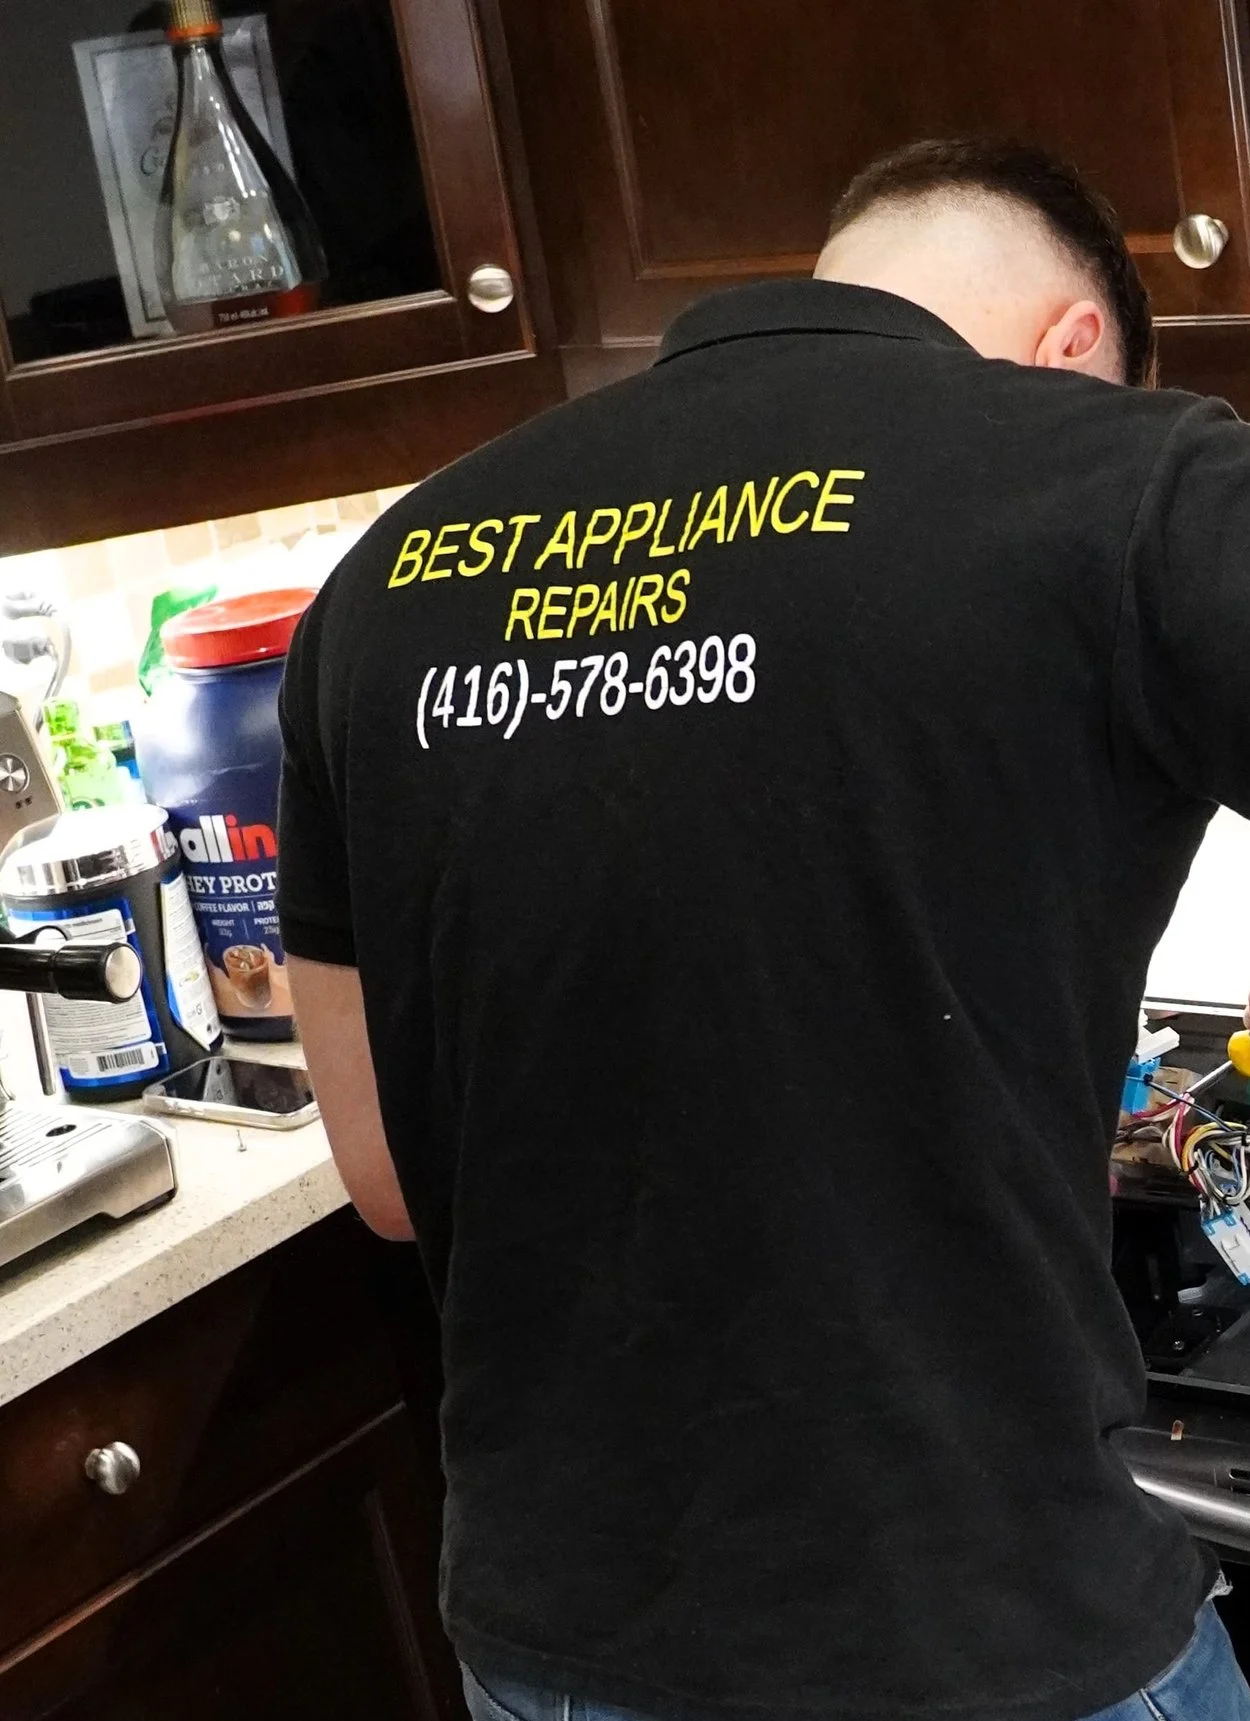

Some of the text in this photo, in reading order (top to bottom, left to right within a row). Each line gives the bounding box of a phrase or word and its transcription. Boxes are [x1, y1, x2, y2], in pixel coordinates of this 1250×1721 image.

[388, 469, 866, 589] BEST APPLIANCE
[504, 569, 691, 642] REPAIRS
[416, 633, 757, 750] (416)-578-6398
[218, 871, 278, 894] PROT
[218, 902, 250, 913] FLAVOR
